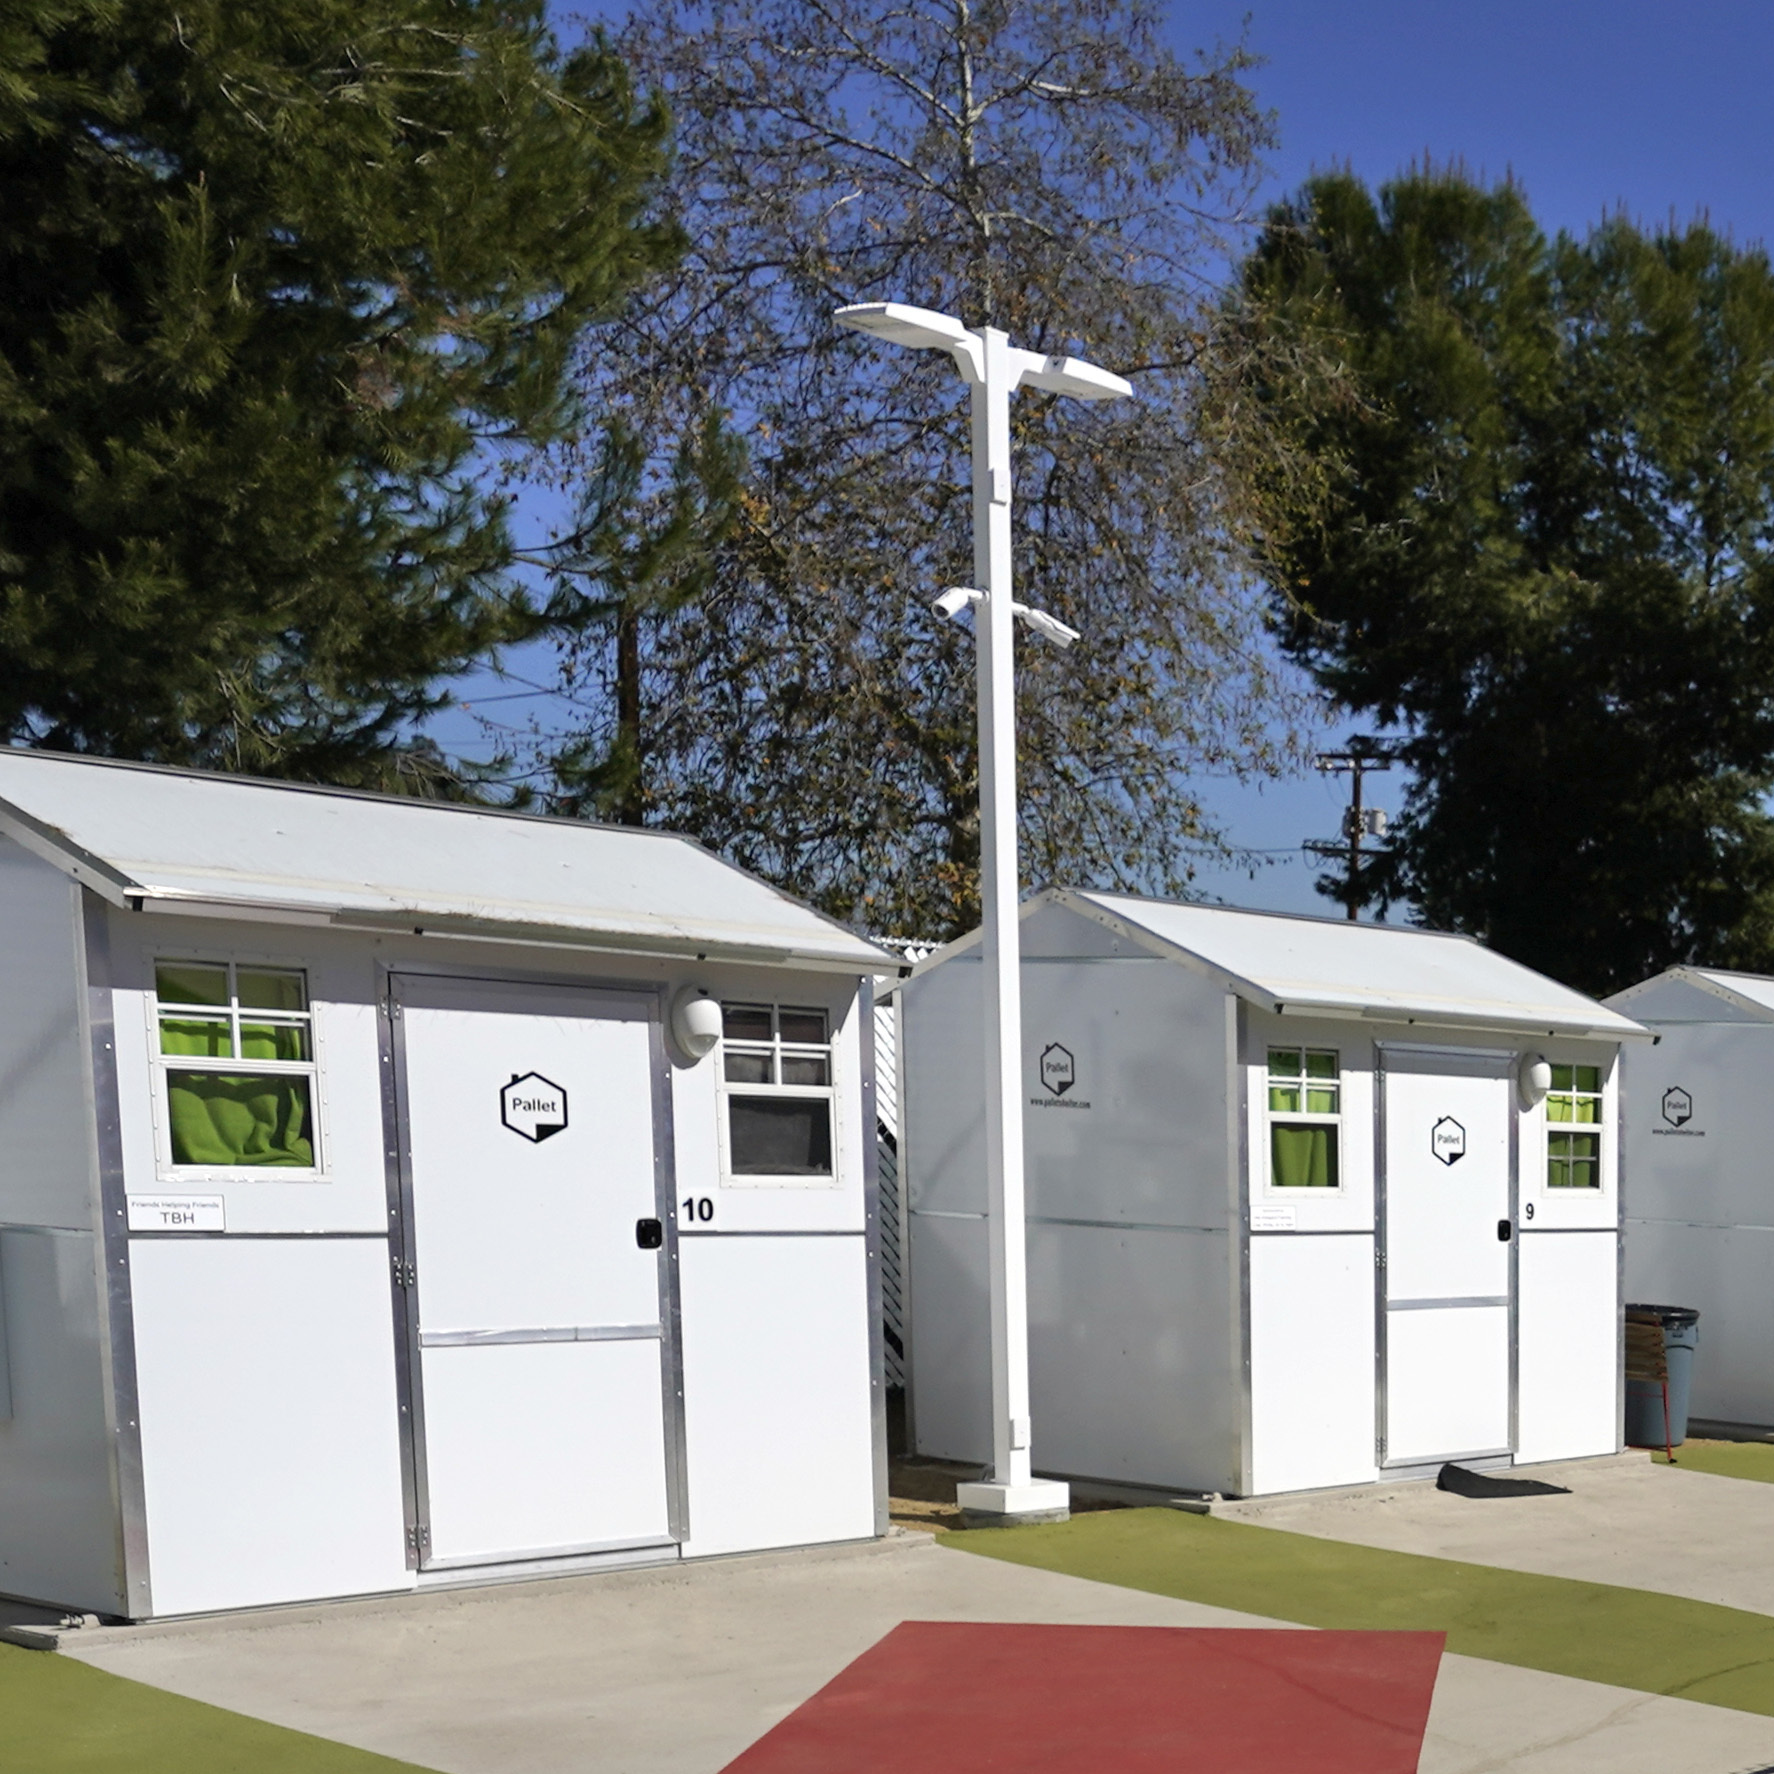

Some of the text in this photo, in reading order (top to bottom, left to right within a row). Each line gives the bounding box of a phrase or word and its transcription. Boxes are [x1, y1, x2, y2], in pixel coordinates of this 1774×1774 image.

[512, 1097, 557, 1112] Pallet
[1437, 1134, 1460, 1145] Pallet
[682, 1197, 714, 1222] 10
[1525, 1203, 1535, 1220] 9
[160, 1212, 195, 1224] TBH
